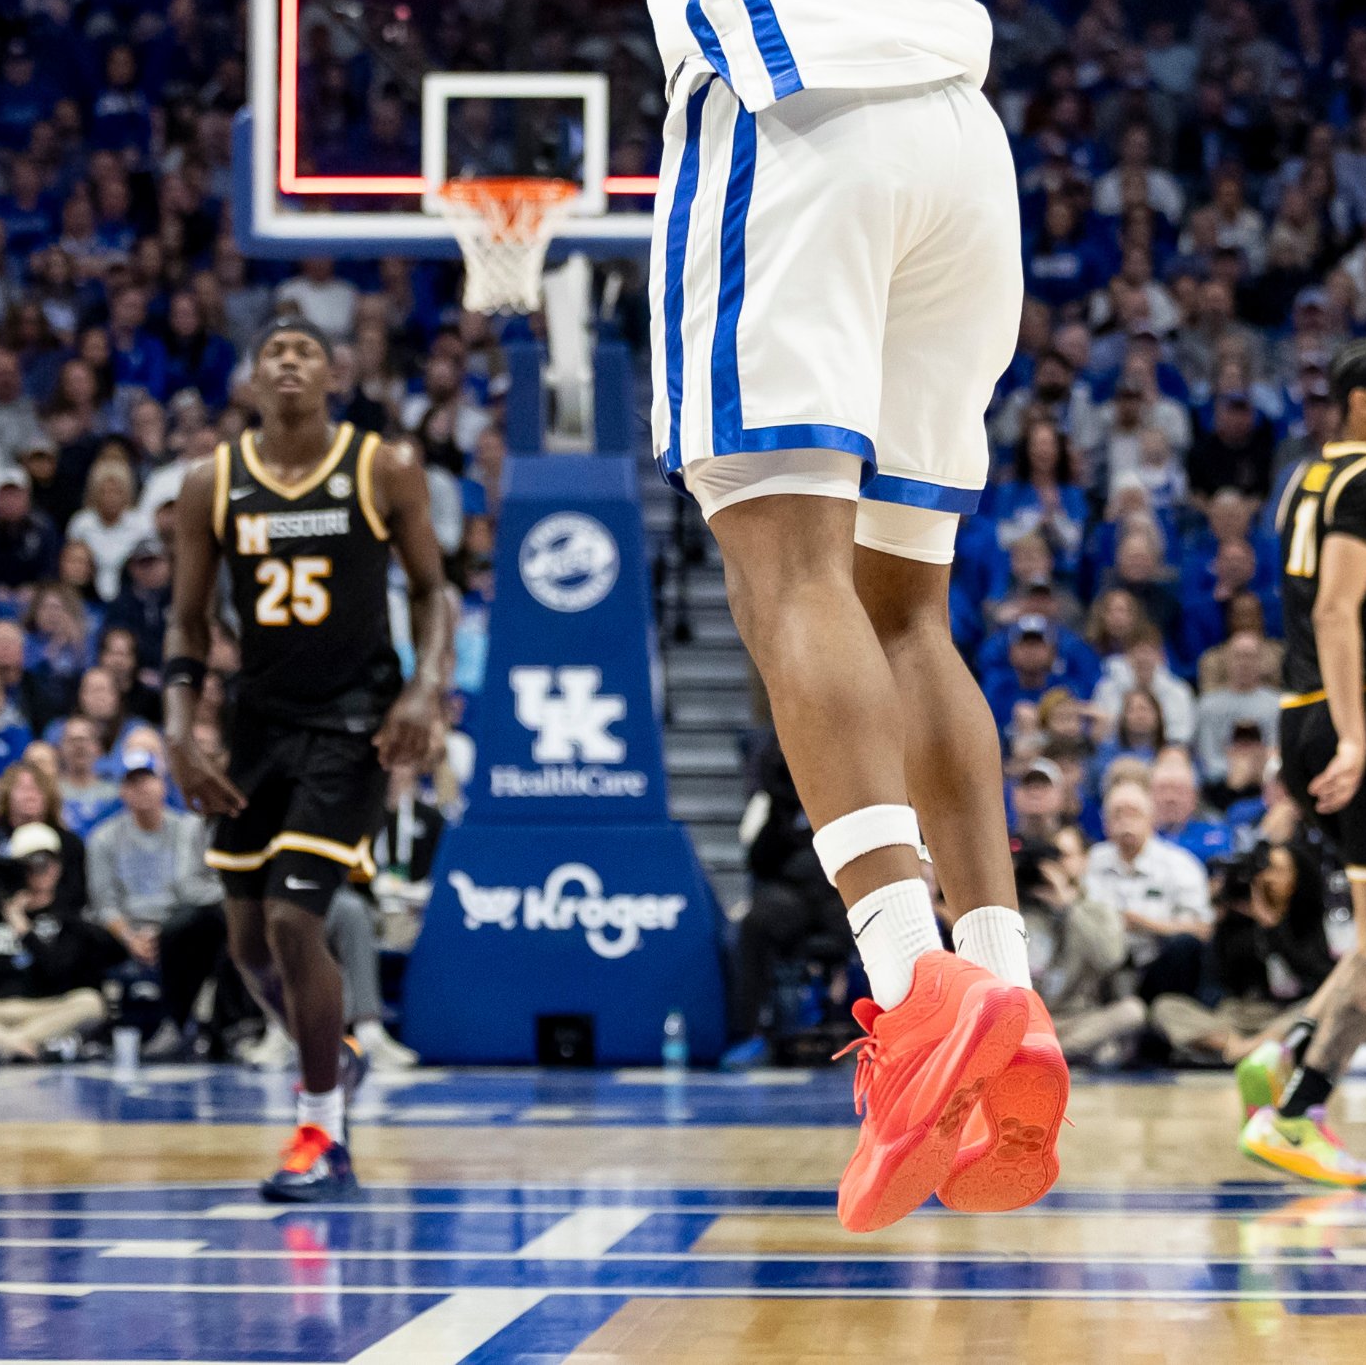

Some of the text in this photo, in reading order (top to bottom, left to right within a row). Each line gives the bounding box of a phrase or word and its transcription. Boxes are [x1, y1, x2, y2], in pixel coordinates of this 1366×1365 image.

[254, 555, 332, 627] 25
[509, 665, 628, 764] UK
[489, 764, 648, 797] HealthCare
[523, 862, 686, 959] Kroger
